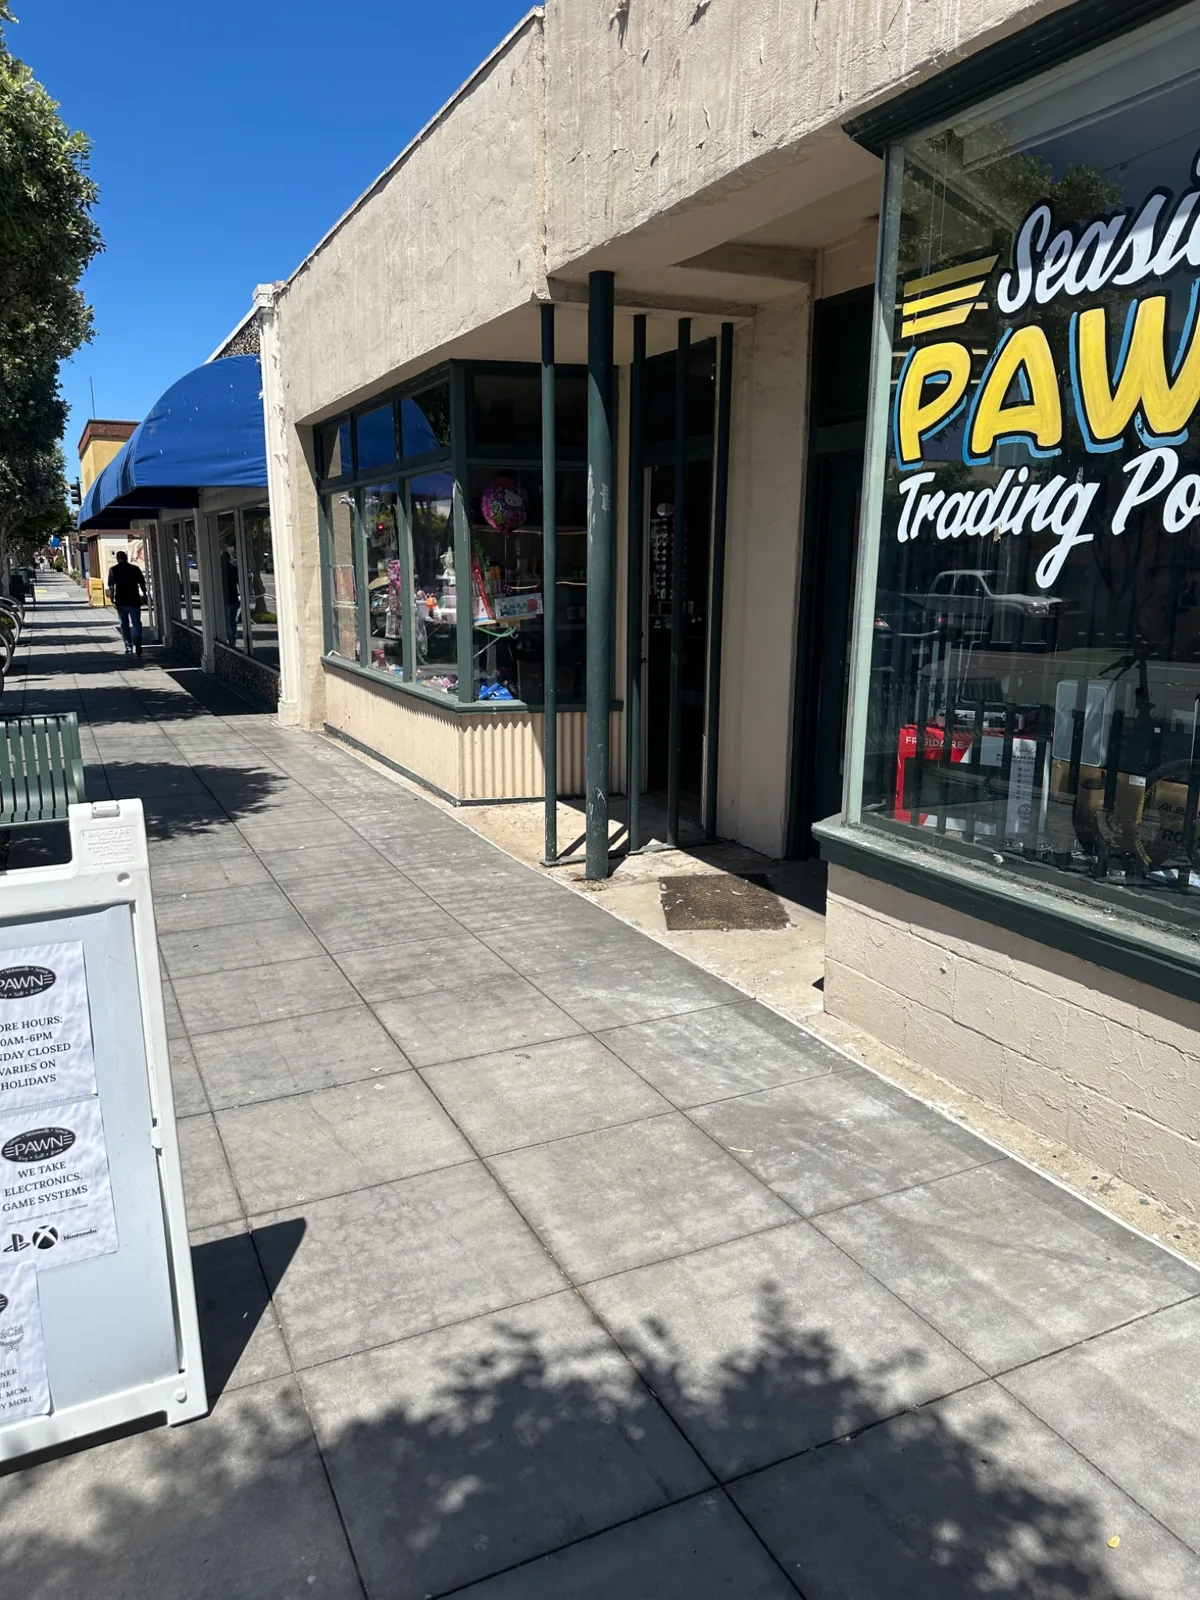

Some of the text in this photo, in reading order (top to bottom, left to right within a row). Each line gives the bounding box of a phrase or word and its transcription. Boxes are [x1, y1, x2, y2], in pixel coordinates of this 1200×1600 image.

[998, 157, 1200, 313] Seasi
[895, 294, 1200, 468] PAW
[897, 448, 1200, 588] Trading Po
[22, 1015, 63, 1029] HOURS:
[0, 1031, 53, 1047] 0AM-6PM
[28, 1043, 71, 1057] CLOSED
[0, 1059, 56, 1076] VARIES ON
[1, 1074, 57, 1091] HOLIDAYS
[14, 1135, 64, 1156] PAWN
[17, 1161, 67, 1178] WE TAKE
[2, 1184, 88, 1212] GAME SYSTEMS
[63, 1228, 97, 1240] Nintendo
[9, 1396, 34, 1407] MORE
